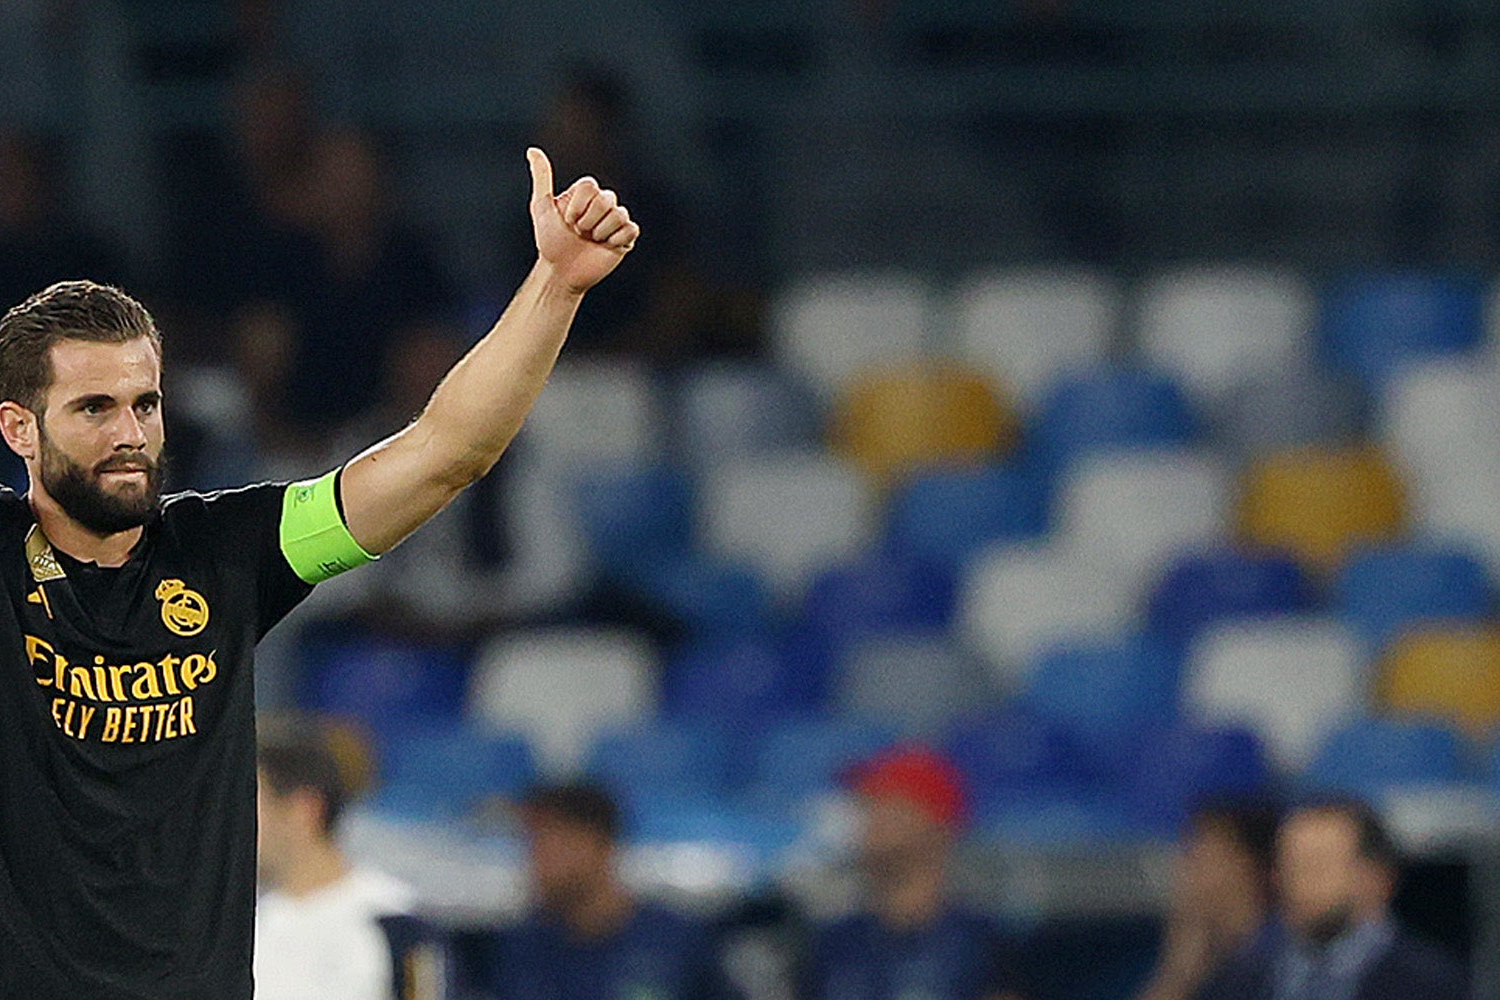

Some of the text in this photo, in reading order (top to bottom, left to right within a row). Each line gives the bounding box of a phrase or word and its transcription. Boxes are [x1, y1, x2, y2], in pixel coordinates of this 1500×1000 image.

[24, 634, 217, 702] Emirates
[51, 696, 197, 744] FLY BETTER
